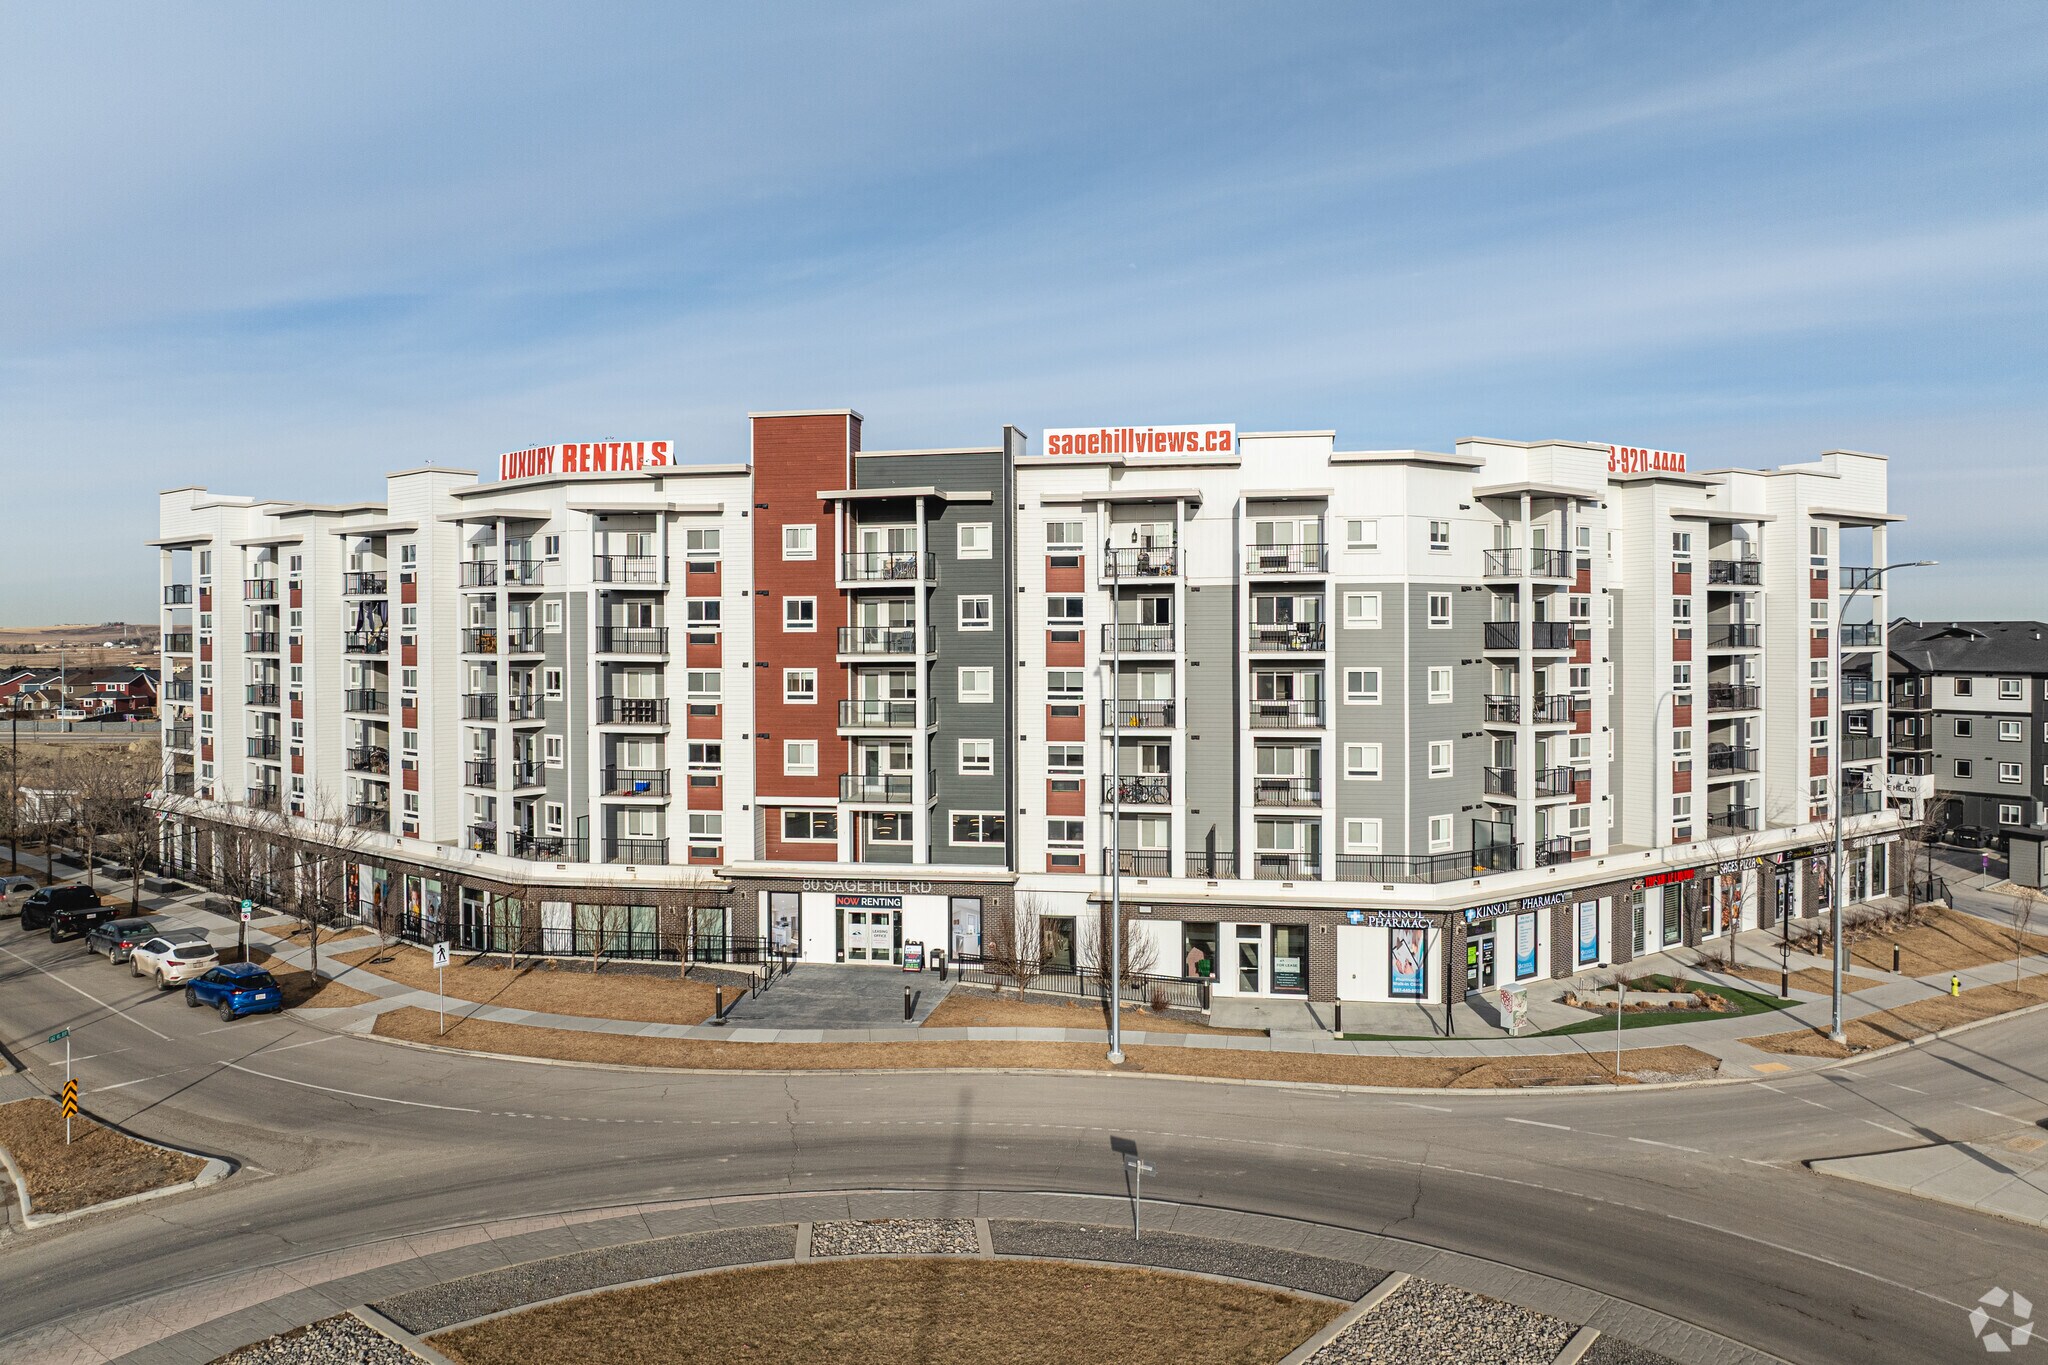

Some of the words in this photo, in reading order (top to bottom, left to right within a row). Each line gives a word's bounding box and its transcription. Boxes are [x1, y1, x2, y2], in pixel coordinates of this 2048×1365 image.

[1048, 427, 1232, 456] sagehillviews.ca
[501, 445, 556, 481] LUXURY
[562, 441, 668, 473] RENTALS
[1719, 861, 1739, 875] SAGES
[1740, 857, 1756, 871] PIZZA
[802, 879, 820, 891] 80
[824, 879, 866, 892] SAGE
[871, 880, 905, 893] HILL
[909, 881, 932, 893] RD
[836, 896, 860, 906] NOW
[861, 897, 901, 907] RENTING
[1476, 902, 1510, 919] KINSOL
[1521, 893, 1567, 910] PHARMACY
[1368, 916, 1434, 929] PHARMACY
[1377, 910, 1425, 919] KINSOL
